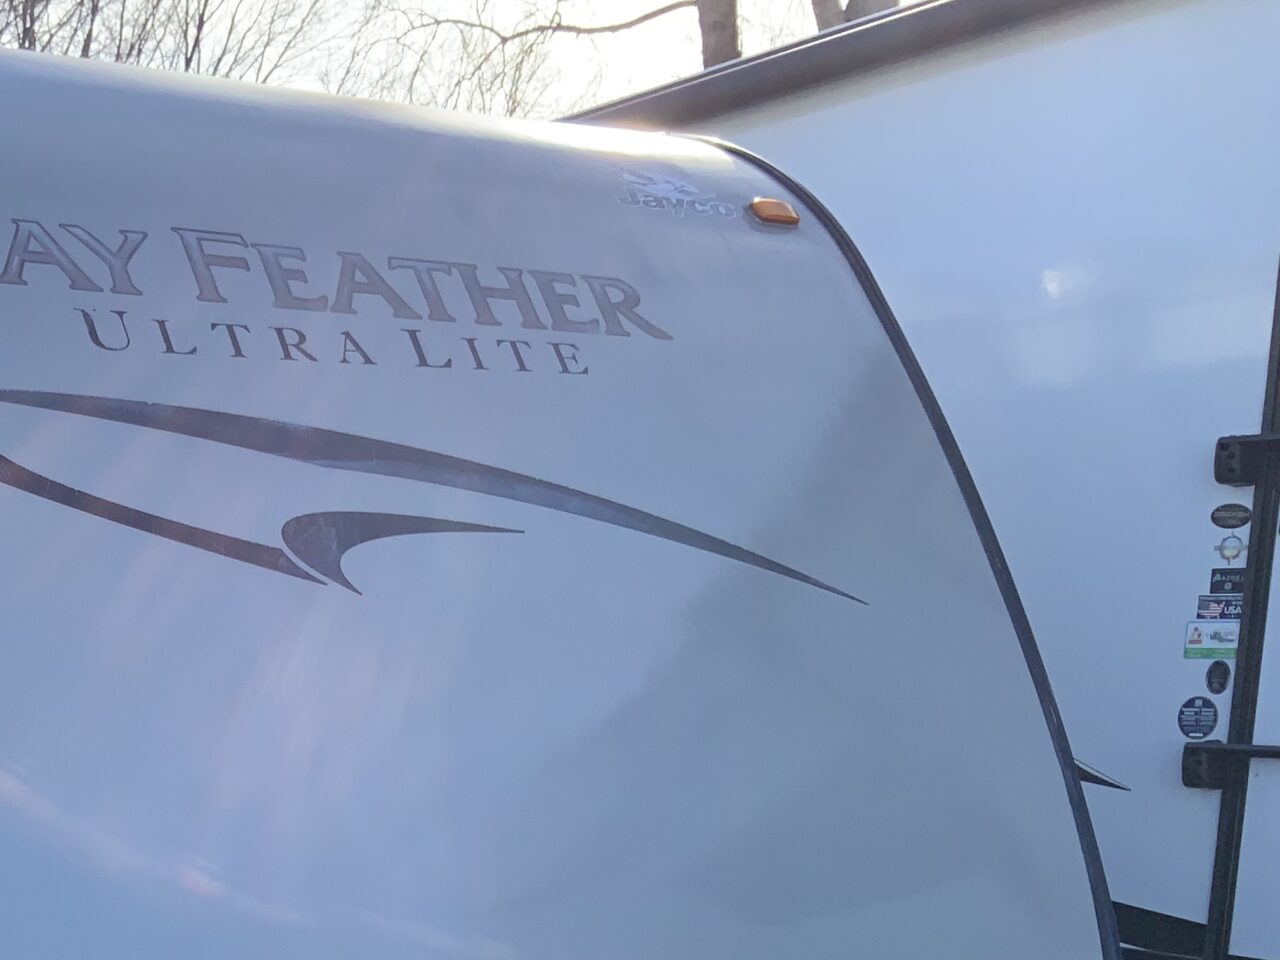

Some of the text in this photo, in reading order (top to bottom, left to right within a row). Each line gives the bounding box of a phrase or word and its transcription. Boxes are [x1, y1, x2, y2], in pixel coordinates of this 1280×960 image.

[170, 226, 675, 342] FEATHER
[72, 307, 590, 376] ULTRA LITE
[1224, 605, 1242, 614] USA
